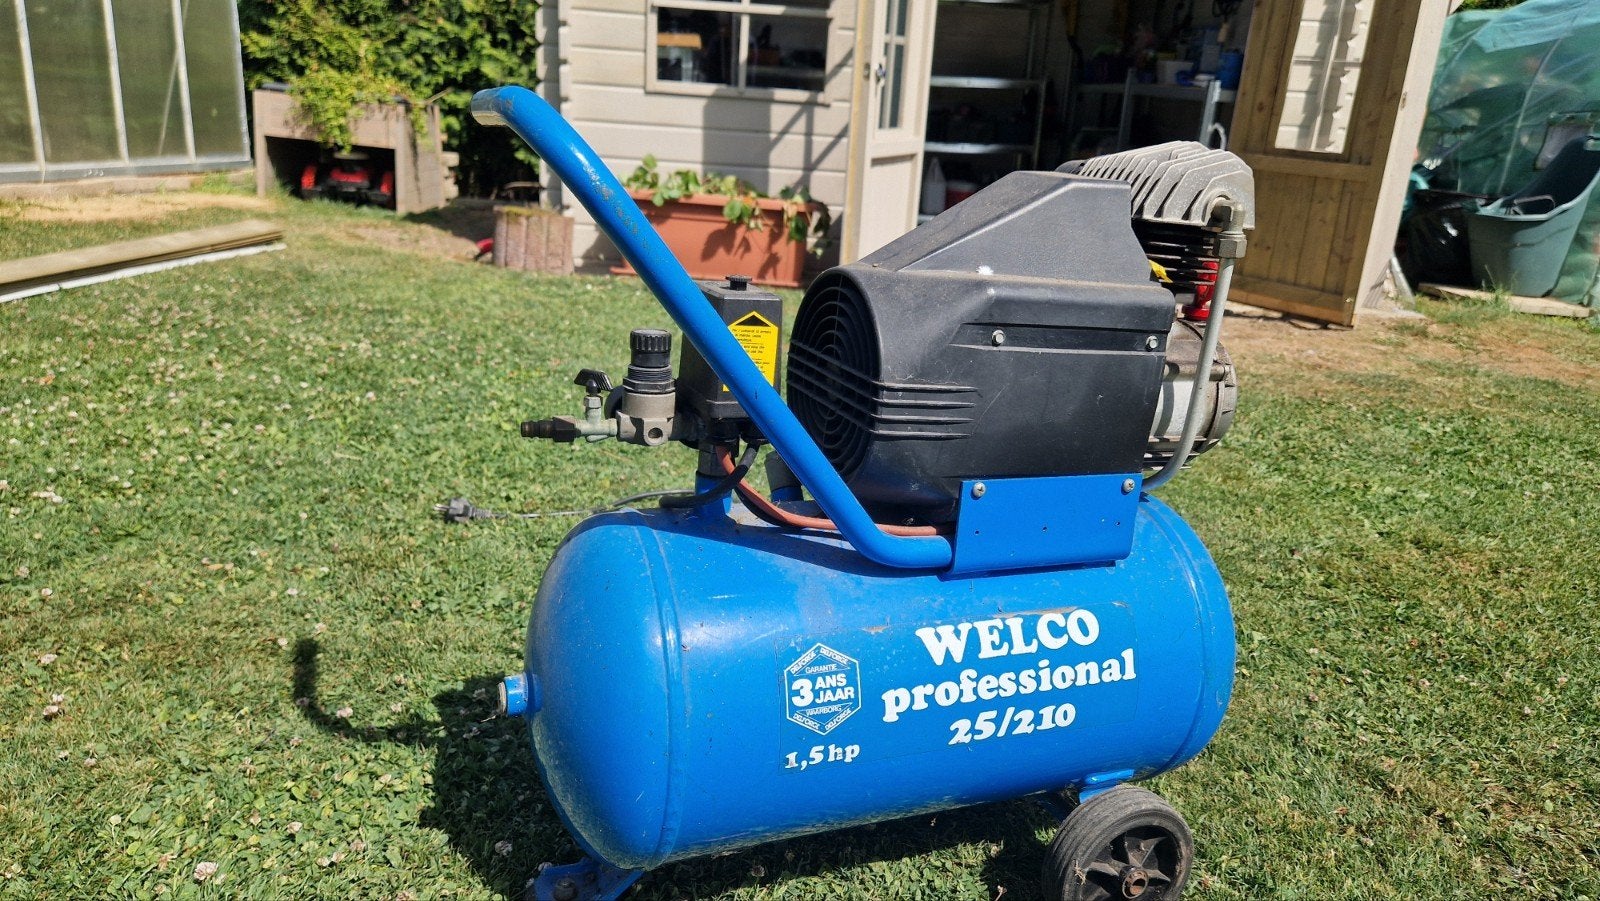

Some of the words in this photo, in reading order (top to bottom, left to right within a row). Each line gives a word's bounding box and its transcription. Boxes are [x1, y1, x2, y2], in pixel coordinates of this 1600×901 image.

[915, 609, 1100, 666] WELCO
[805, 663, 838, 674] GARANTIE
[881, 648, 1136, 723] professional
[791, 678, 815, 707] 3
[815, 673, 847, 690] ANS
[815, 686, 855, 704] JAAR
[948, 703, 1077, 745] 25/210
